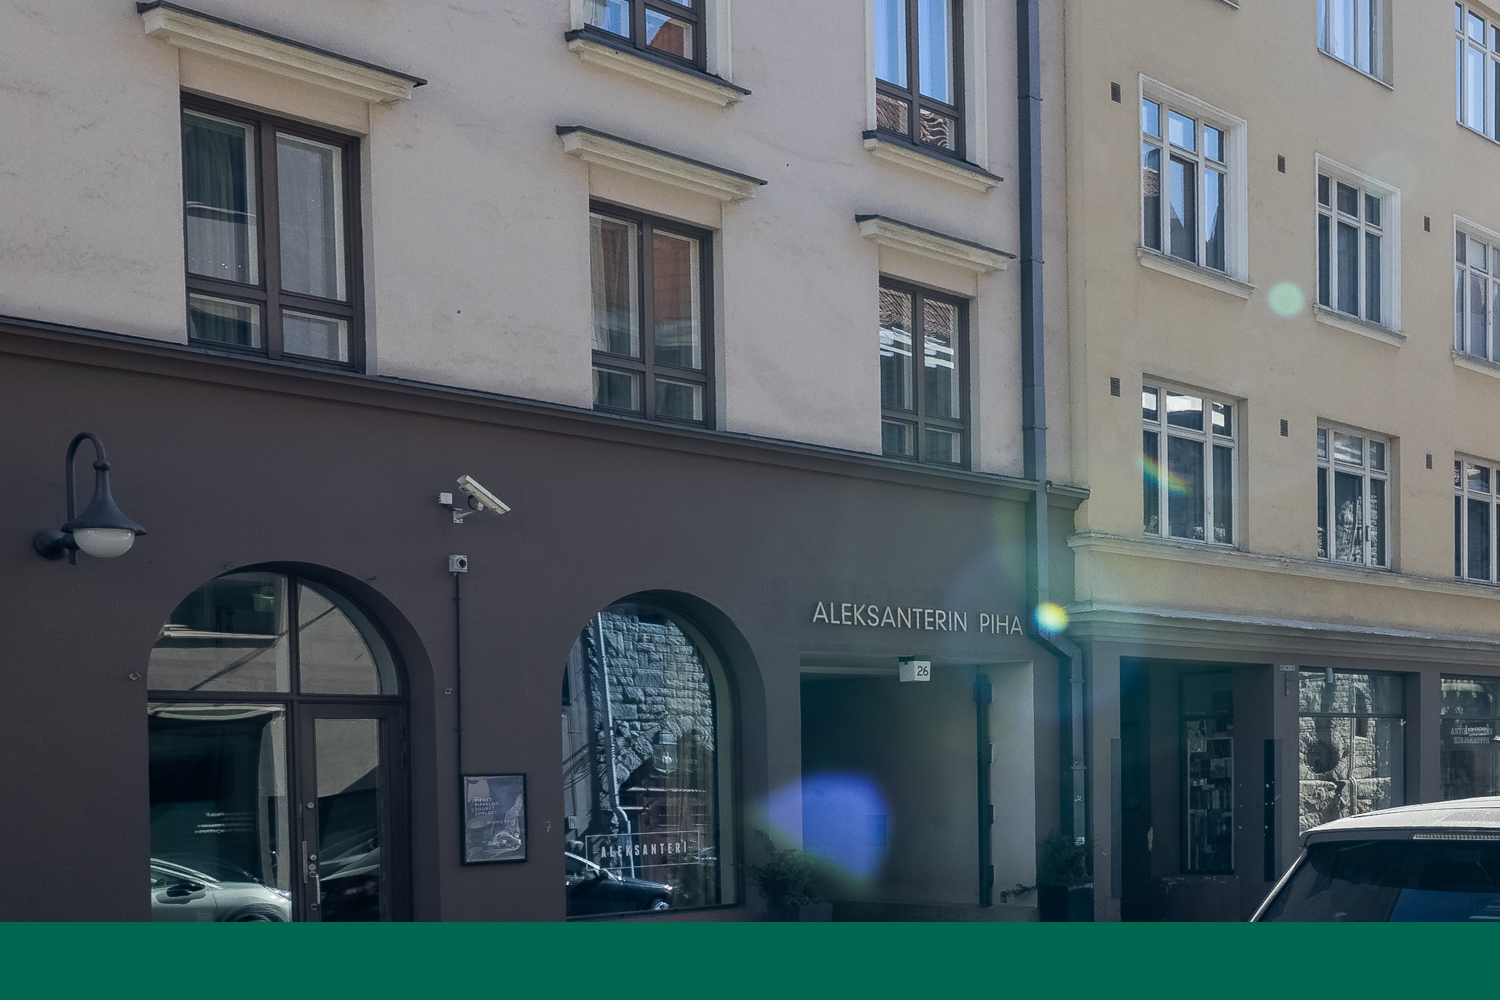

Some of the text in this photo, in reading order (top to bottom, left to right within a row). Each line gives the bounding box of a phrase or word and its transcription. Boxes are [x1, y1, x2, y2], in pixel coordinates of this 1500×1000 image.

[812, 601, 1024, 636] ALEKSANTERIN PIHA
[916, 665, 929, 677] 26
[600, 840, 687, 858] ALEKSANTERI
